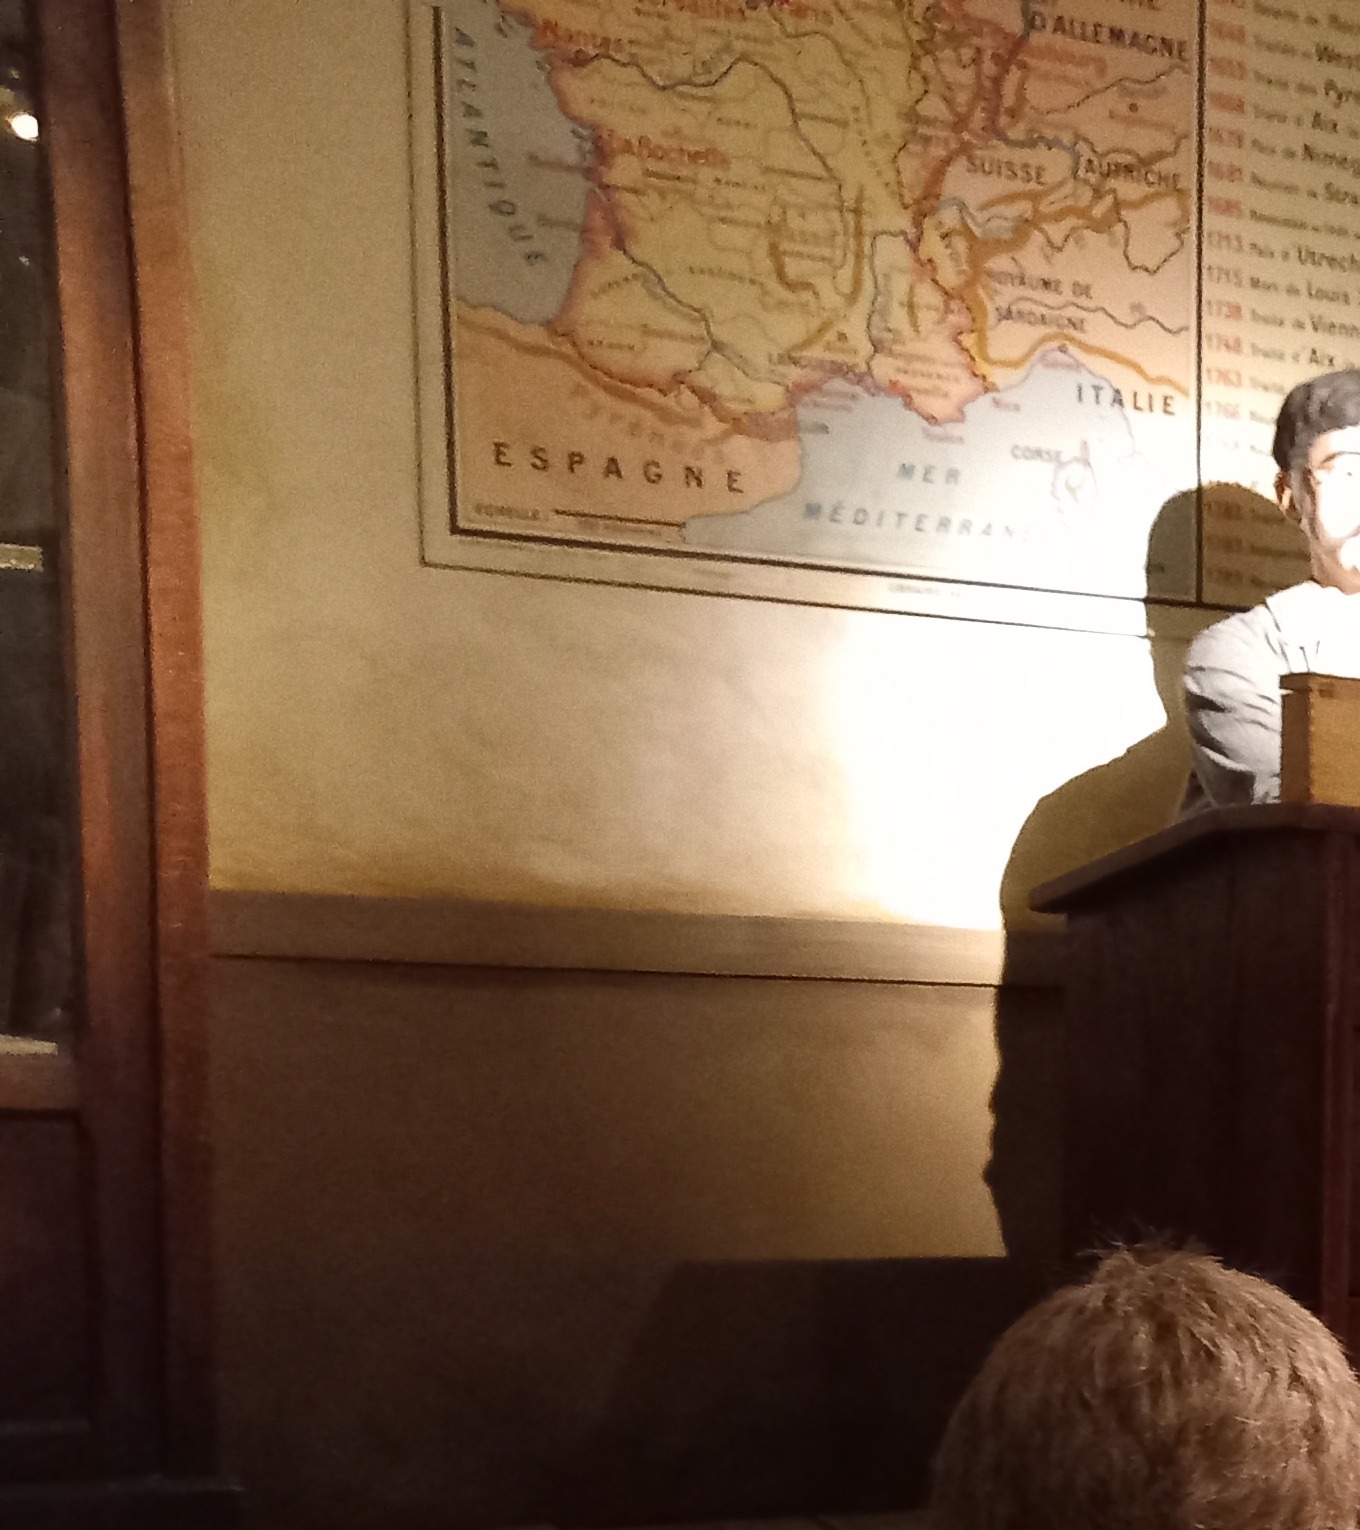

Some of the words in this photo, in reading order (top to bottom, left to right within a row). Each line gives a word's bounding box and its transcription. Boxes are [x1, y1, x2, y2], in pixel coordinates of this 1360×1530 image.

[454, 26, 549, 266] ATLANTIQUE
[966, 154, 1047, 186] SUISSE
[1084, 157, 1181, 189] AUTRICHE
[1207, 230, 1244, 254] 1713
[1072, 281, 1094, 300] DE
[1307, 281, 1351, 306] Louis
[1077, 384, 1176, 416] ITALIE
[492, 441, 744, 495] ESPAGNE
[1011, 444, 1063, 464] CORSE
[898, 462, 961, 486] MER
